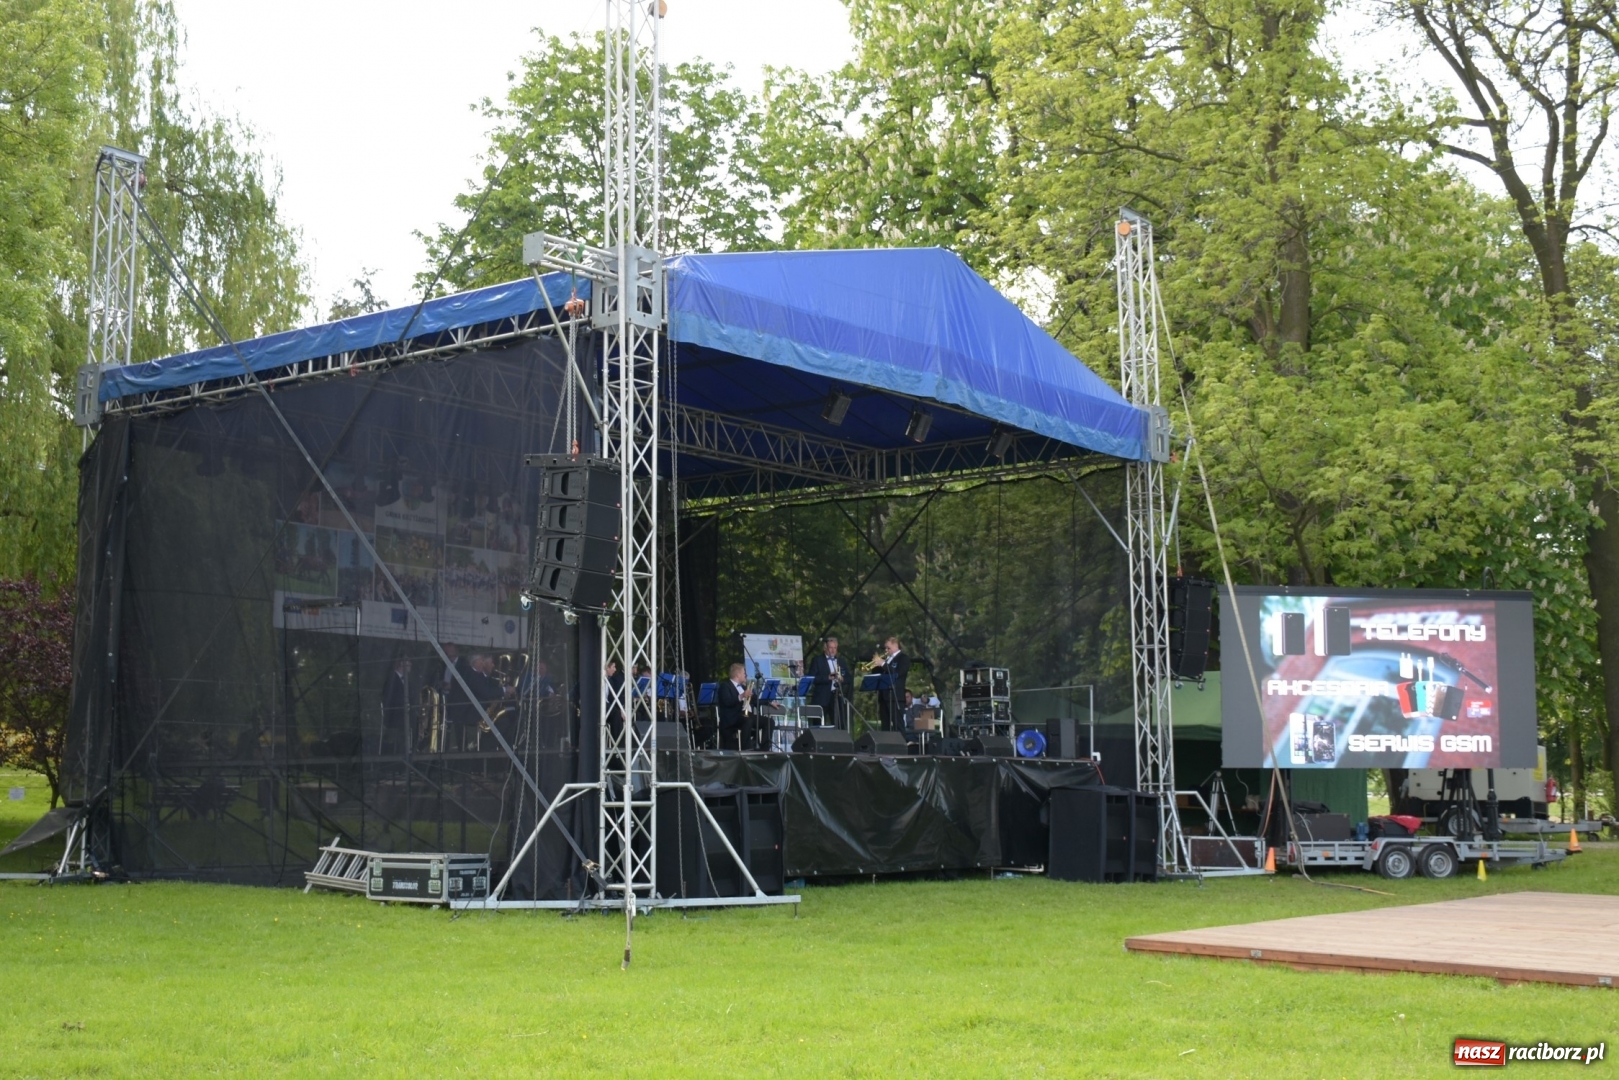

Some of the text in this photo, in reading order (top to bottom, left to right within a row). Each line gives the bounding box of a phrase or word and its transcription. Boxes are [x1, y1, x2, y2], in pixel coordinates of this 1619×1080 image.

[1360, 623, 1486, 642] TELEFONY
[1267, 679, 1389, 696] AKCESORIA
[1348, 734, 1492, 752] SERWIS GSM
